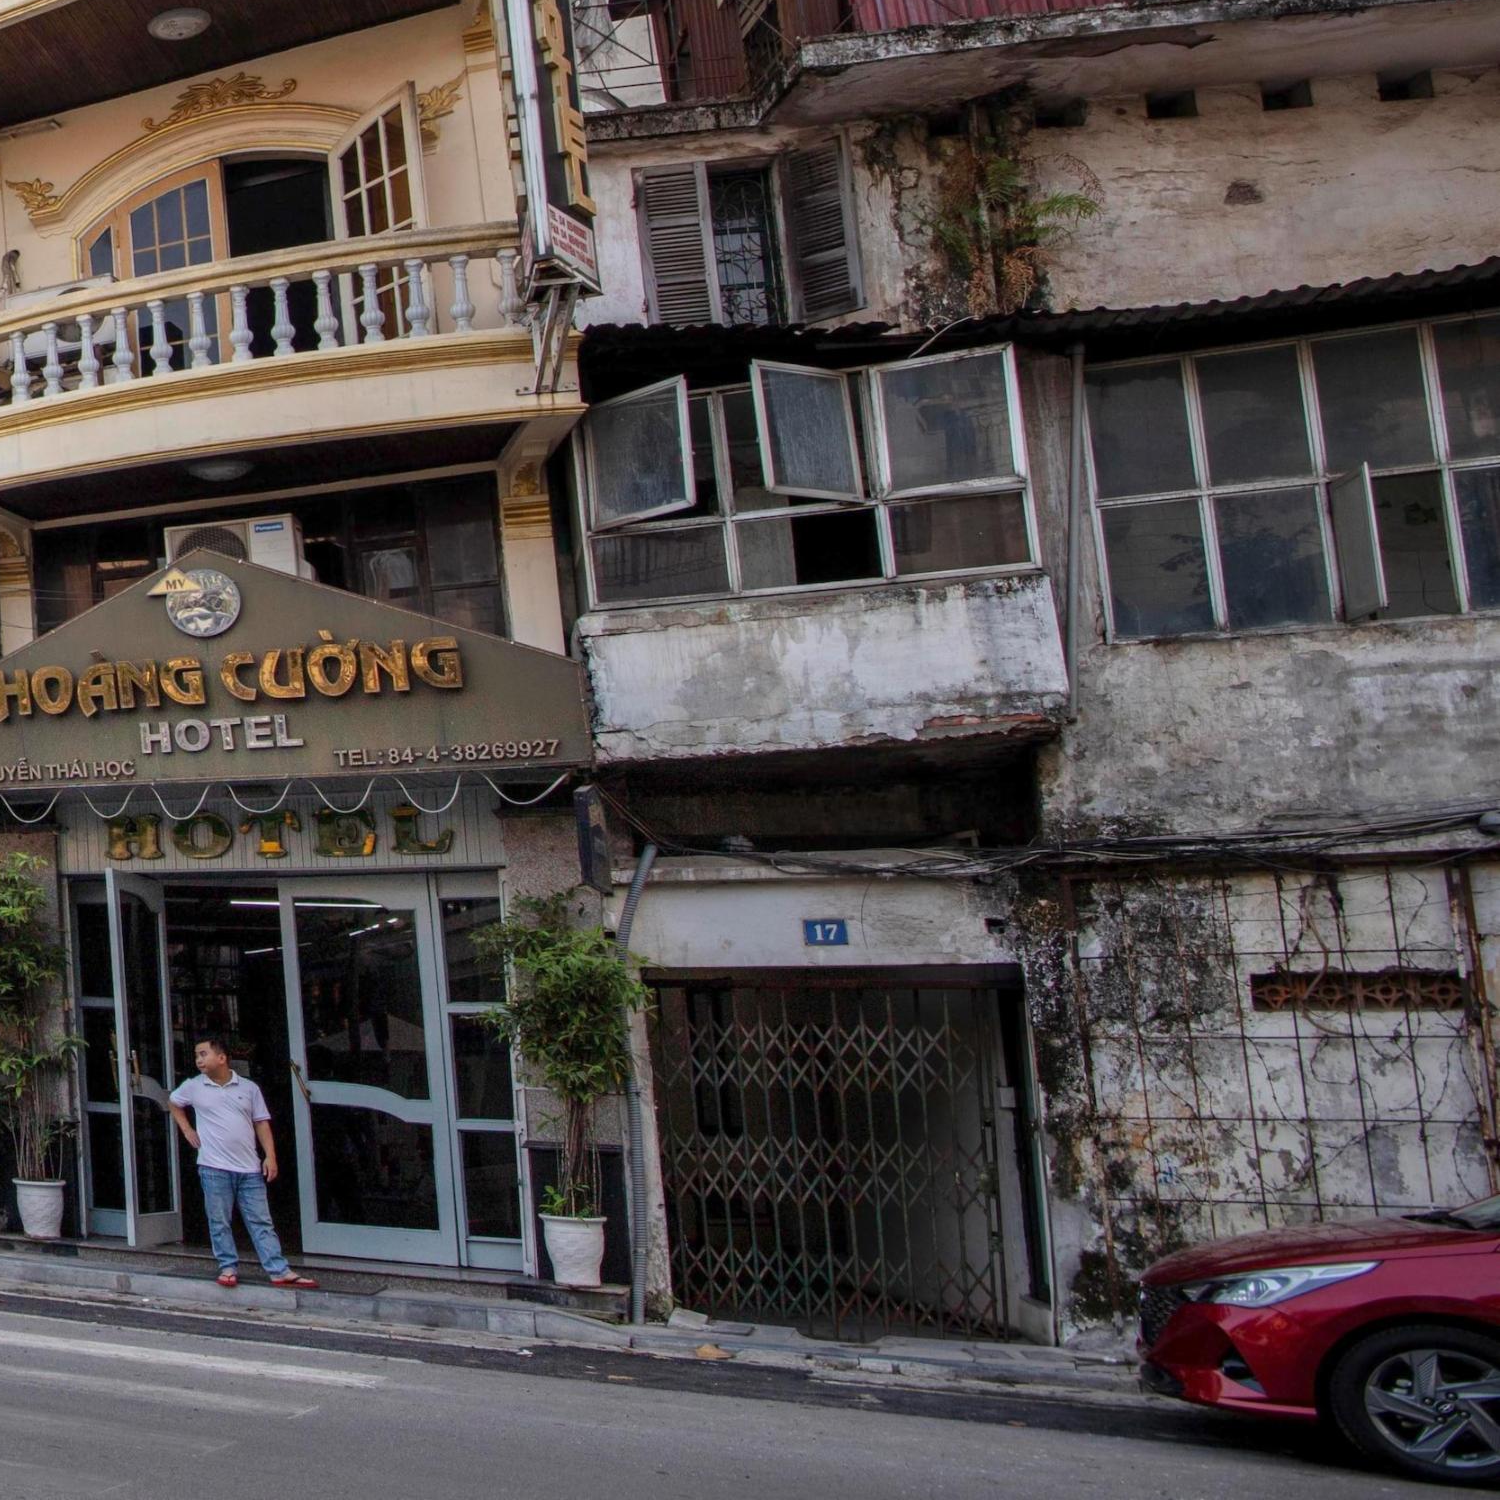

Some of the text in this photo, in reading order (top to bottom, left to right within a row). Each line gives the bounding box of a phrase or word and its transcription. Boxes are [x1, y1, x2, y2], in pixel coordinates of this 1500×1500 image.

[165, 578, 187, 591] MV
[219, 629, 464, 702] CƯỜNG
[139, 713, 305, 755] HOTEL
[388, 738, 560, 766] 84-4-38269927
[45, 758, 89, 781] THÁI
[92, 760, 136, 781] HỌC
[103, 805, 457, 860] HOTEL
[813, 923, 838, 941] 17
